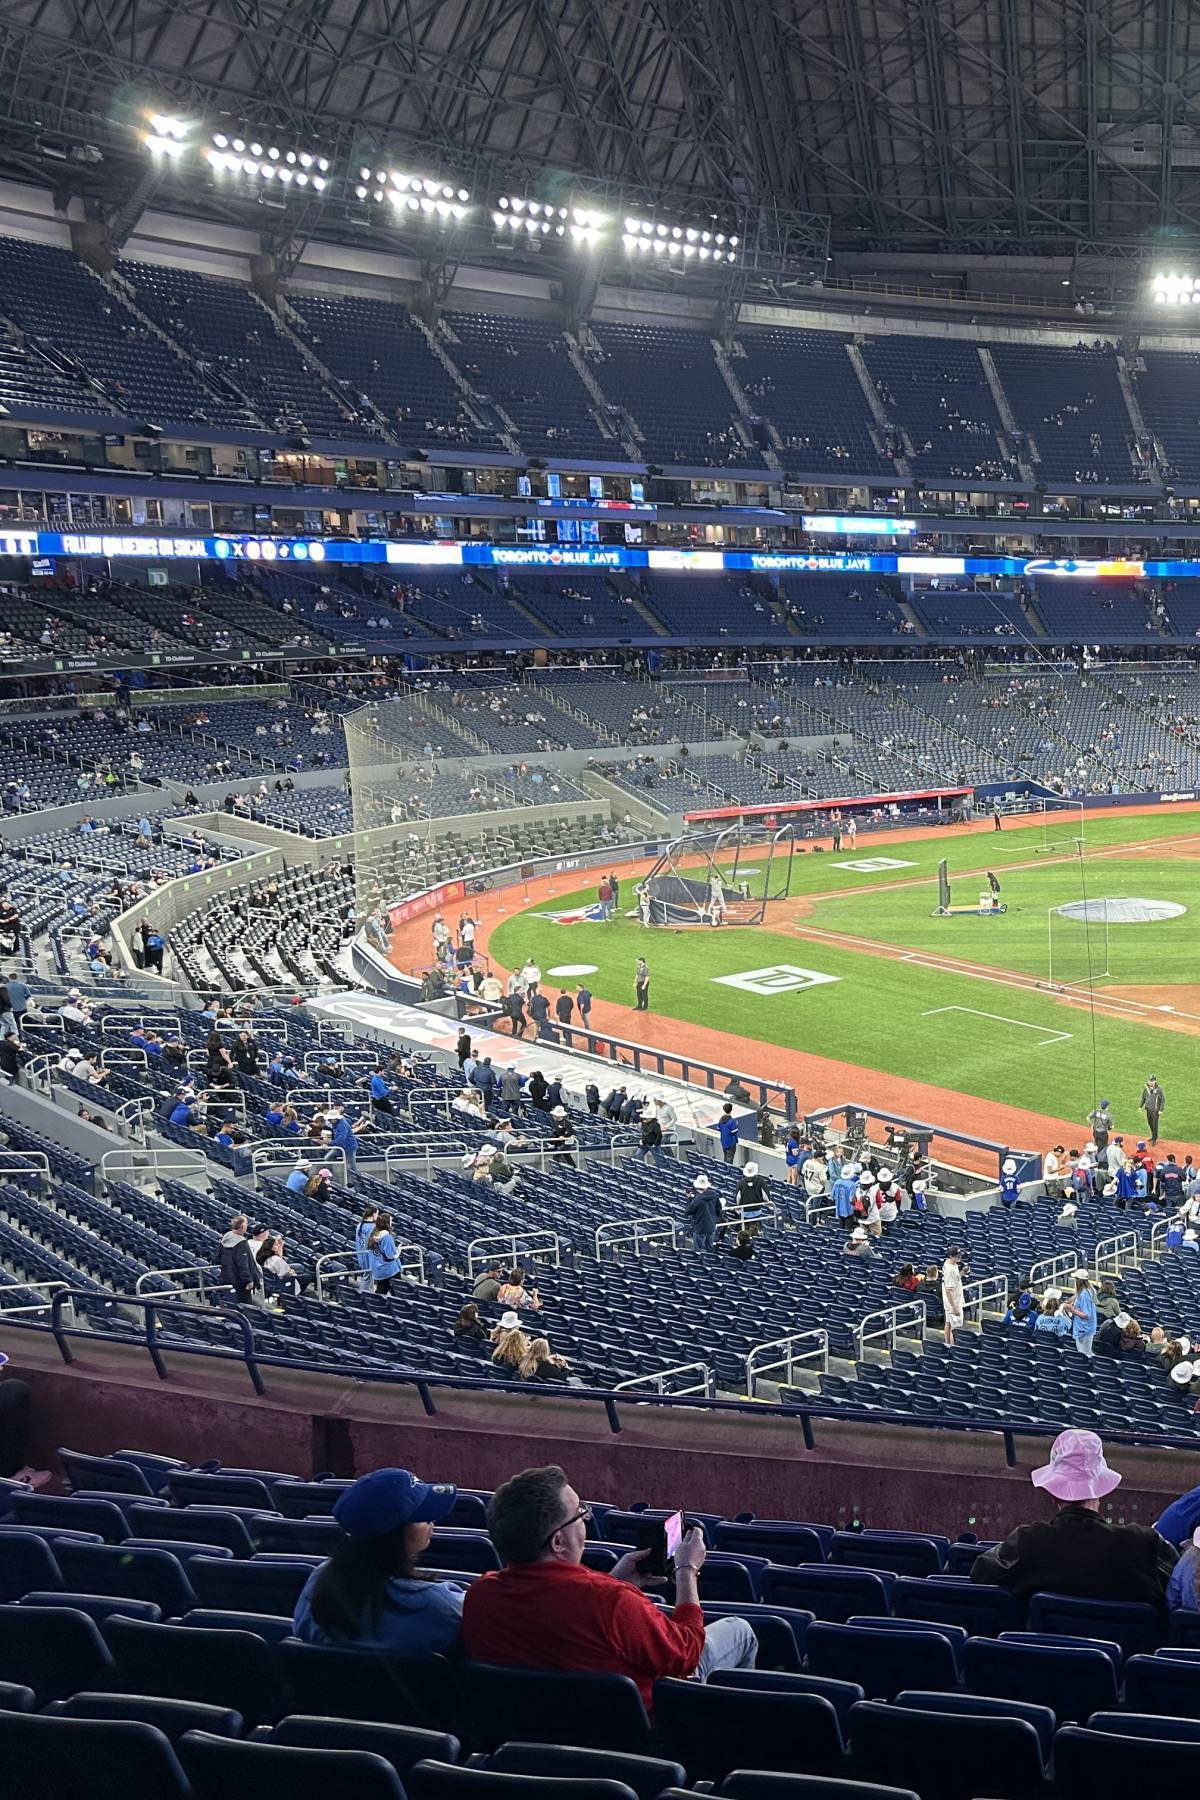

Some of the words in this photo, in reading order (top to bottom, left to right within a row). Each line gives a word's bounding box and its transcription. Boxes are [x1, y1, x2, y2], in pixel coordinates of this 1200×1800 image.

[174, 540, 209, 557] SOCIAL
[491, 550, 549, 563] TORONTO
[561, 551, 590, 564] BLUE
[592, 552, 620, 564] JAYS
[751, 556, 805, 569] TORONTO
[817, 557, 844, 569] BLUE
[846, 558, 871, 570] JAYS
[150, 571, 167, 584] TD
[1160, 793, 1195, 802] theScore
[743, 969, 815, 988] TD
